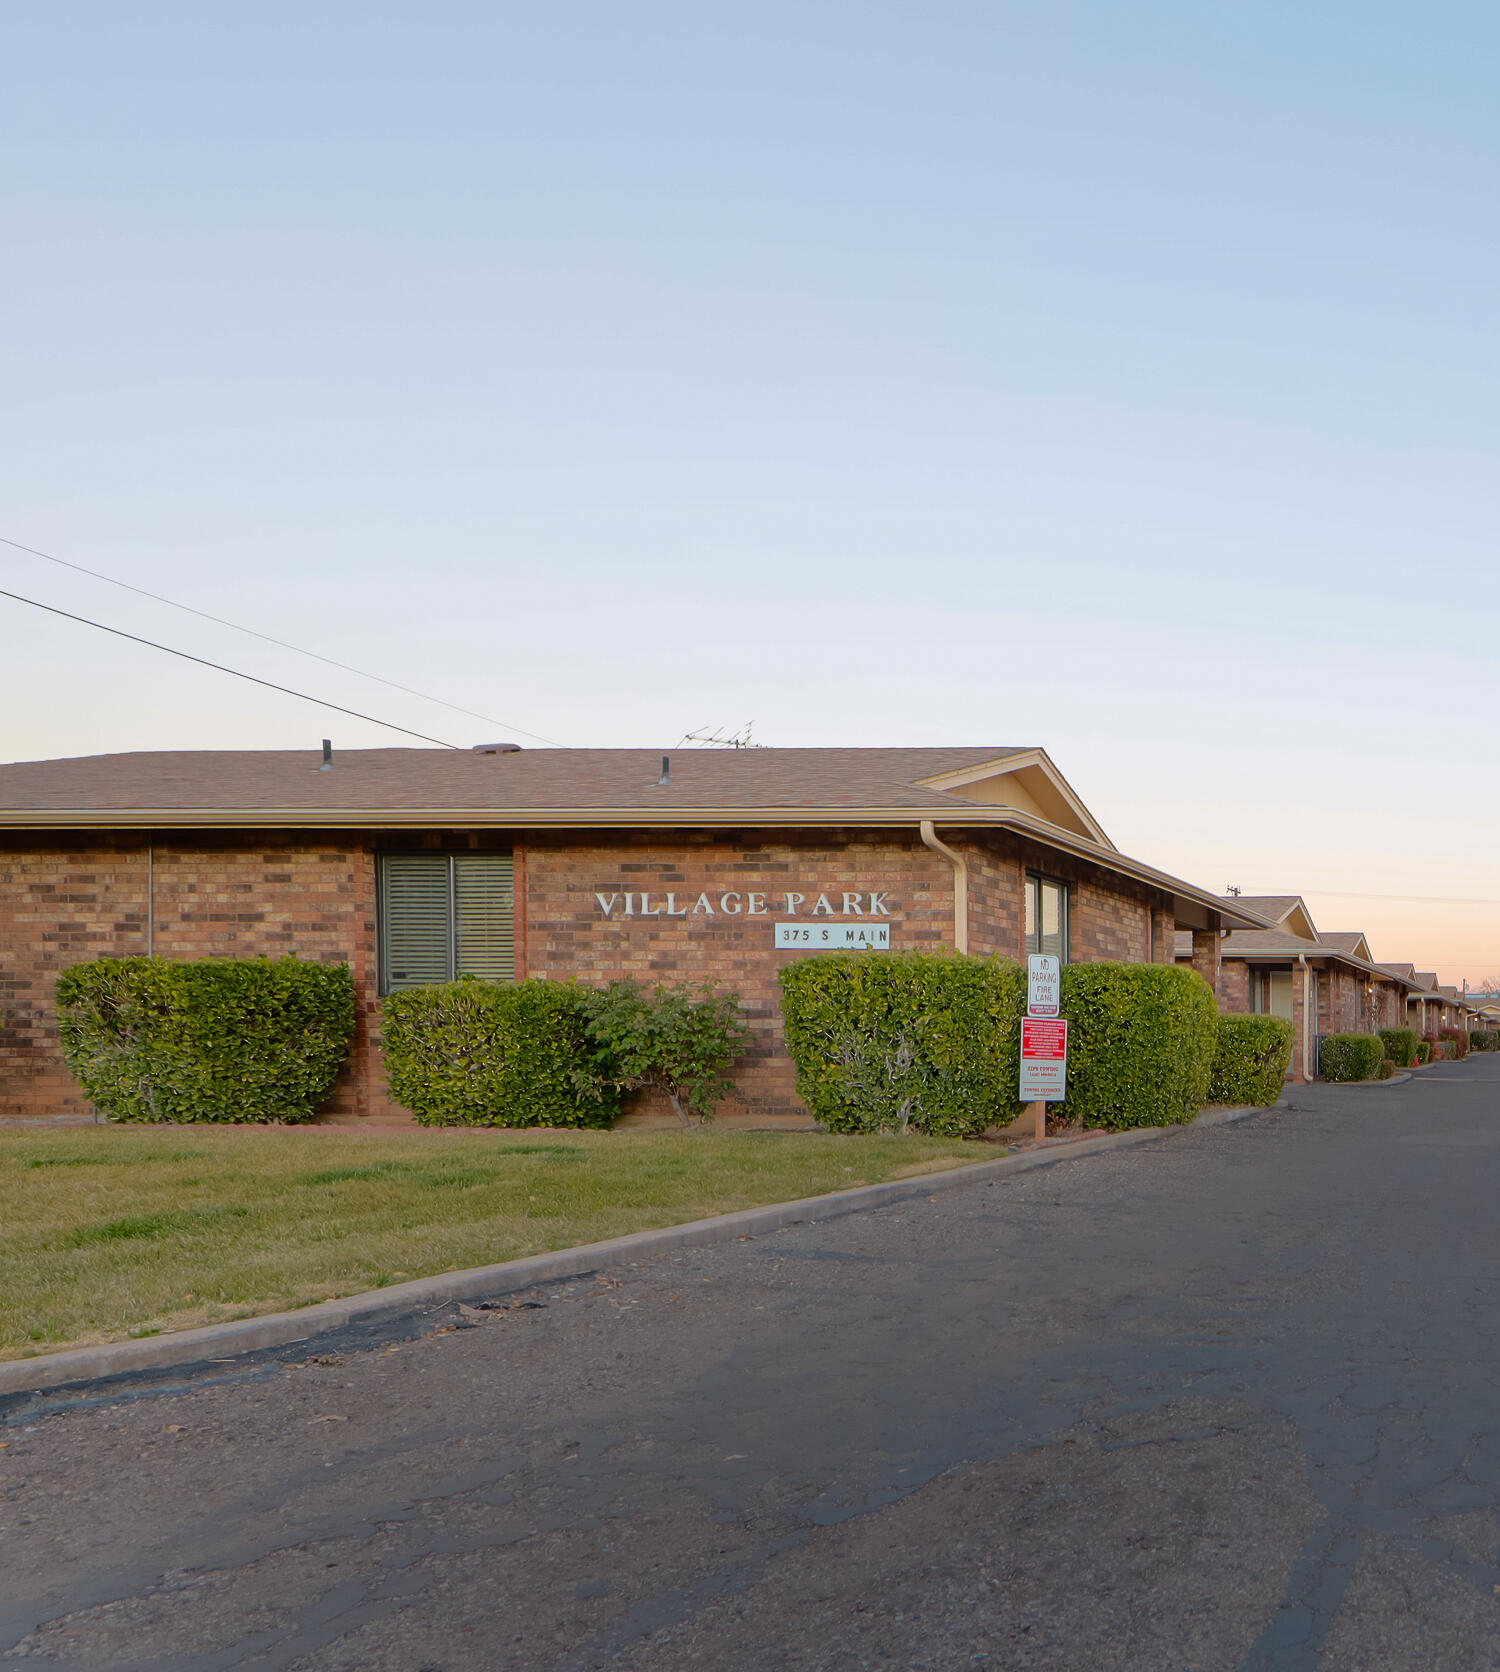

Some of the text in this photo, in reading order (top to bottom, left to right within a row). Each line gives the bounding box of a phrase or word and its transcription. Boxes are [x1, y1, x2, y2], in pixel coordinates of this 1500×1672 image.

[595, 892, 890, 916] VILLAGE PARK
[783, 930, 887, 941] 375 S MAIN
[1040, 959, 1050, 970] NO
[1032, 972, 1057, 983] PARKING
[1037, 986, 1052, 994] FIRE
[1035, 994, 1053, 1002] LANE
